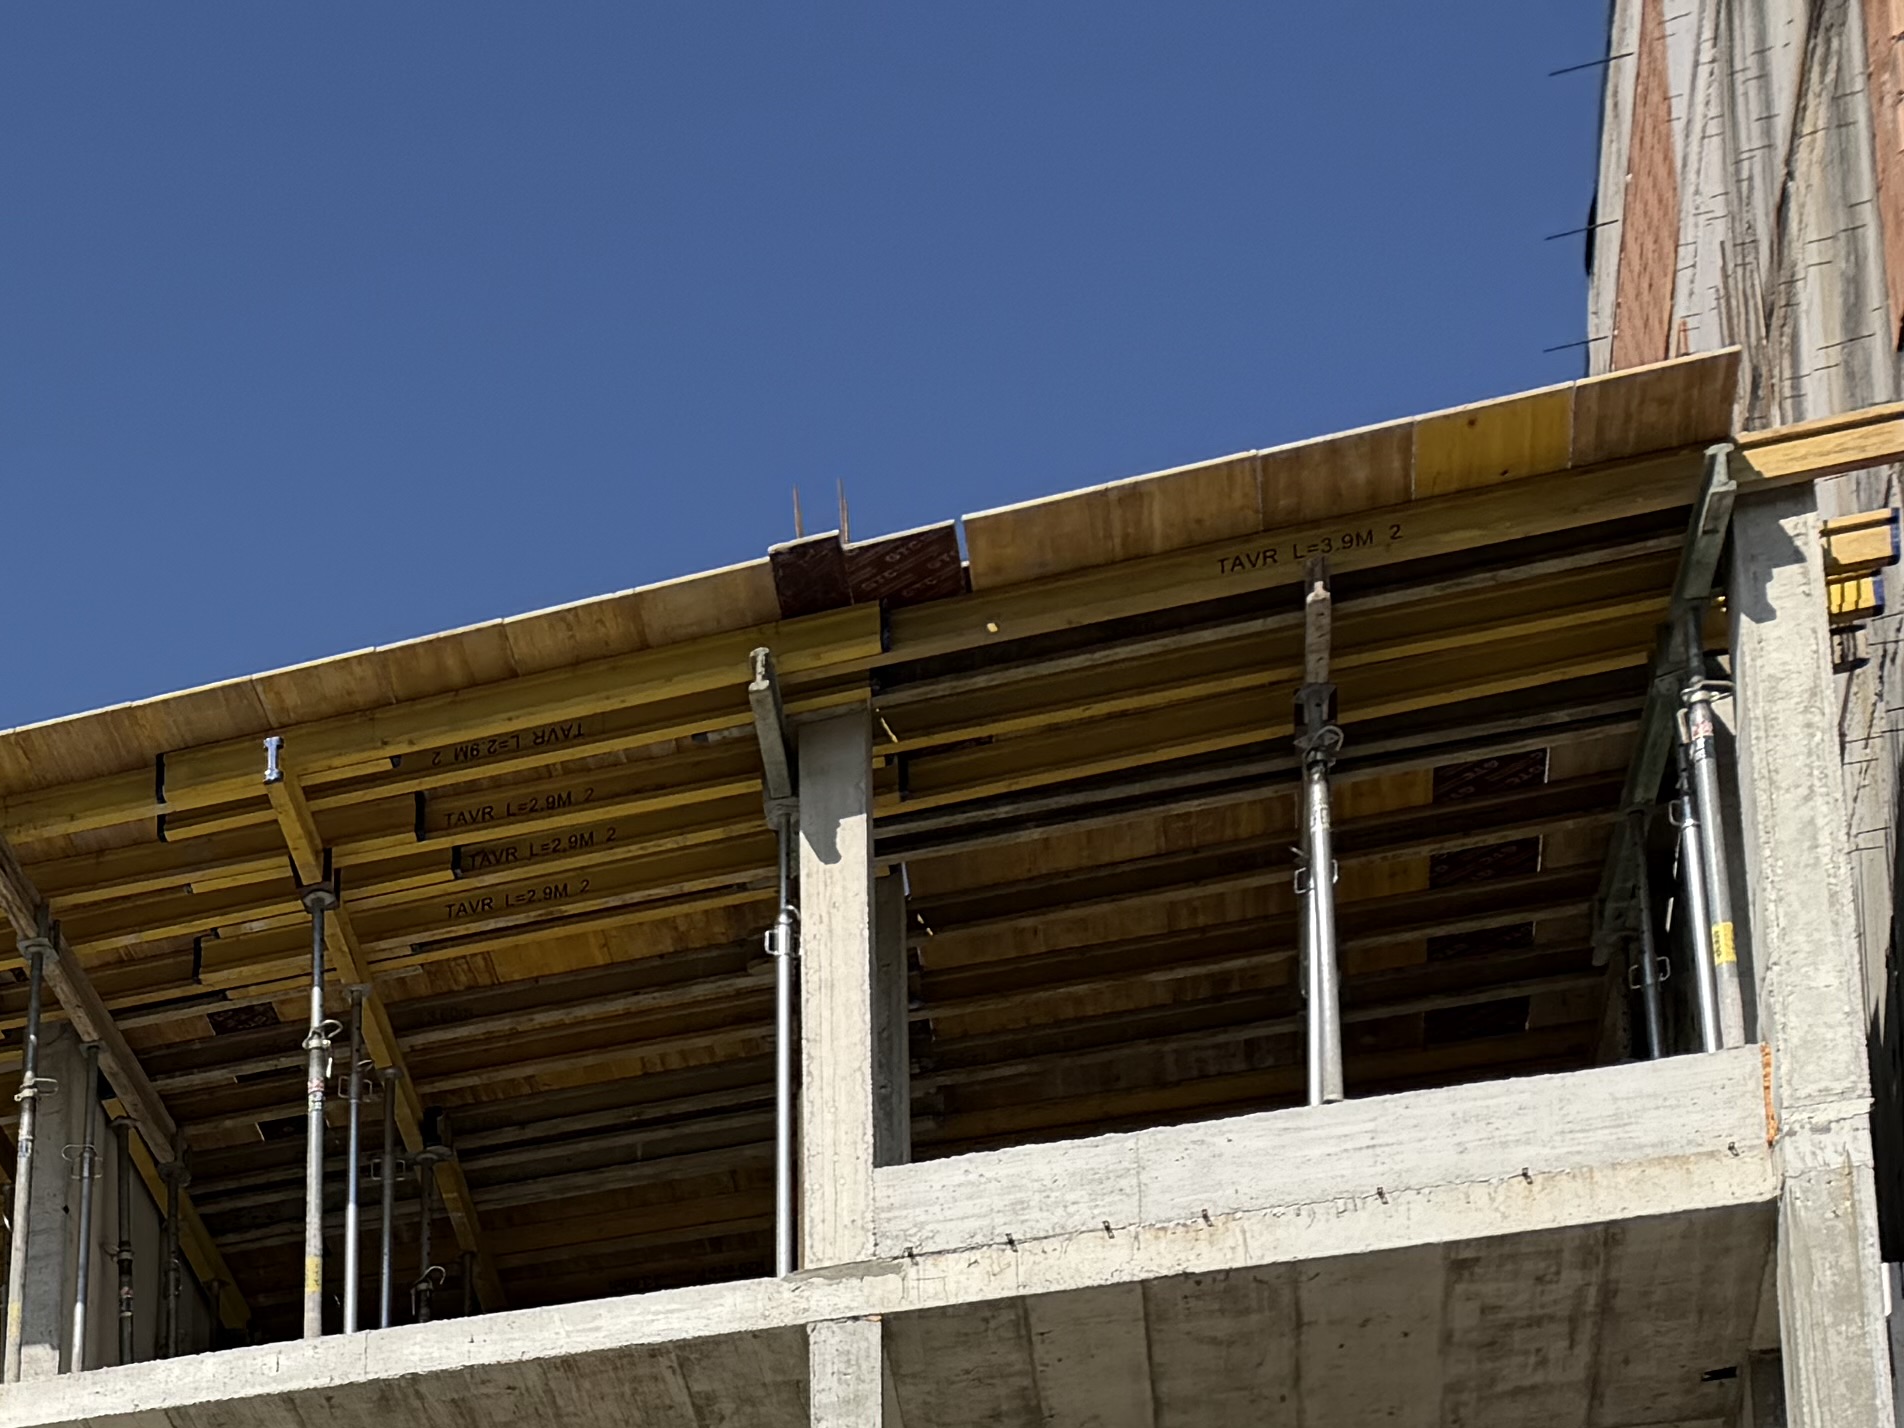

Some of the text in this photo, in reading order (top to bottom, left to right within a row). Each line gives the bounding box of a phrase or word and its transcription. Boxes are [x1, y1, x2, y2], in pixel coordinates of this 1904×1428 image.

[1218, 524, 1403, 574] TAVR L=3.9M 2
[431, 722, 585, 766] TAVR L=2.9M 2
[444, 805, 494, 827] TAVR
[506, 791, 572, 817] L=2.9M
[468, 827, 617, 869] TAVR L=2.9M 2
[445, 879, 591, 919] TAVR L=2.9M 2
